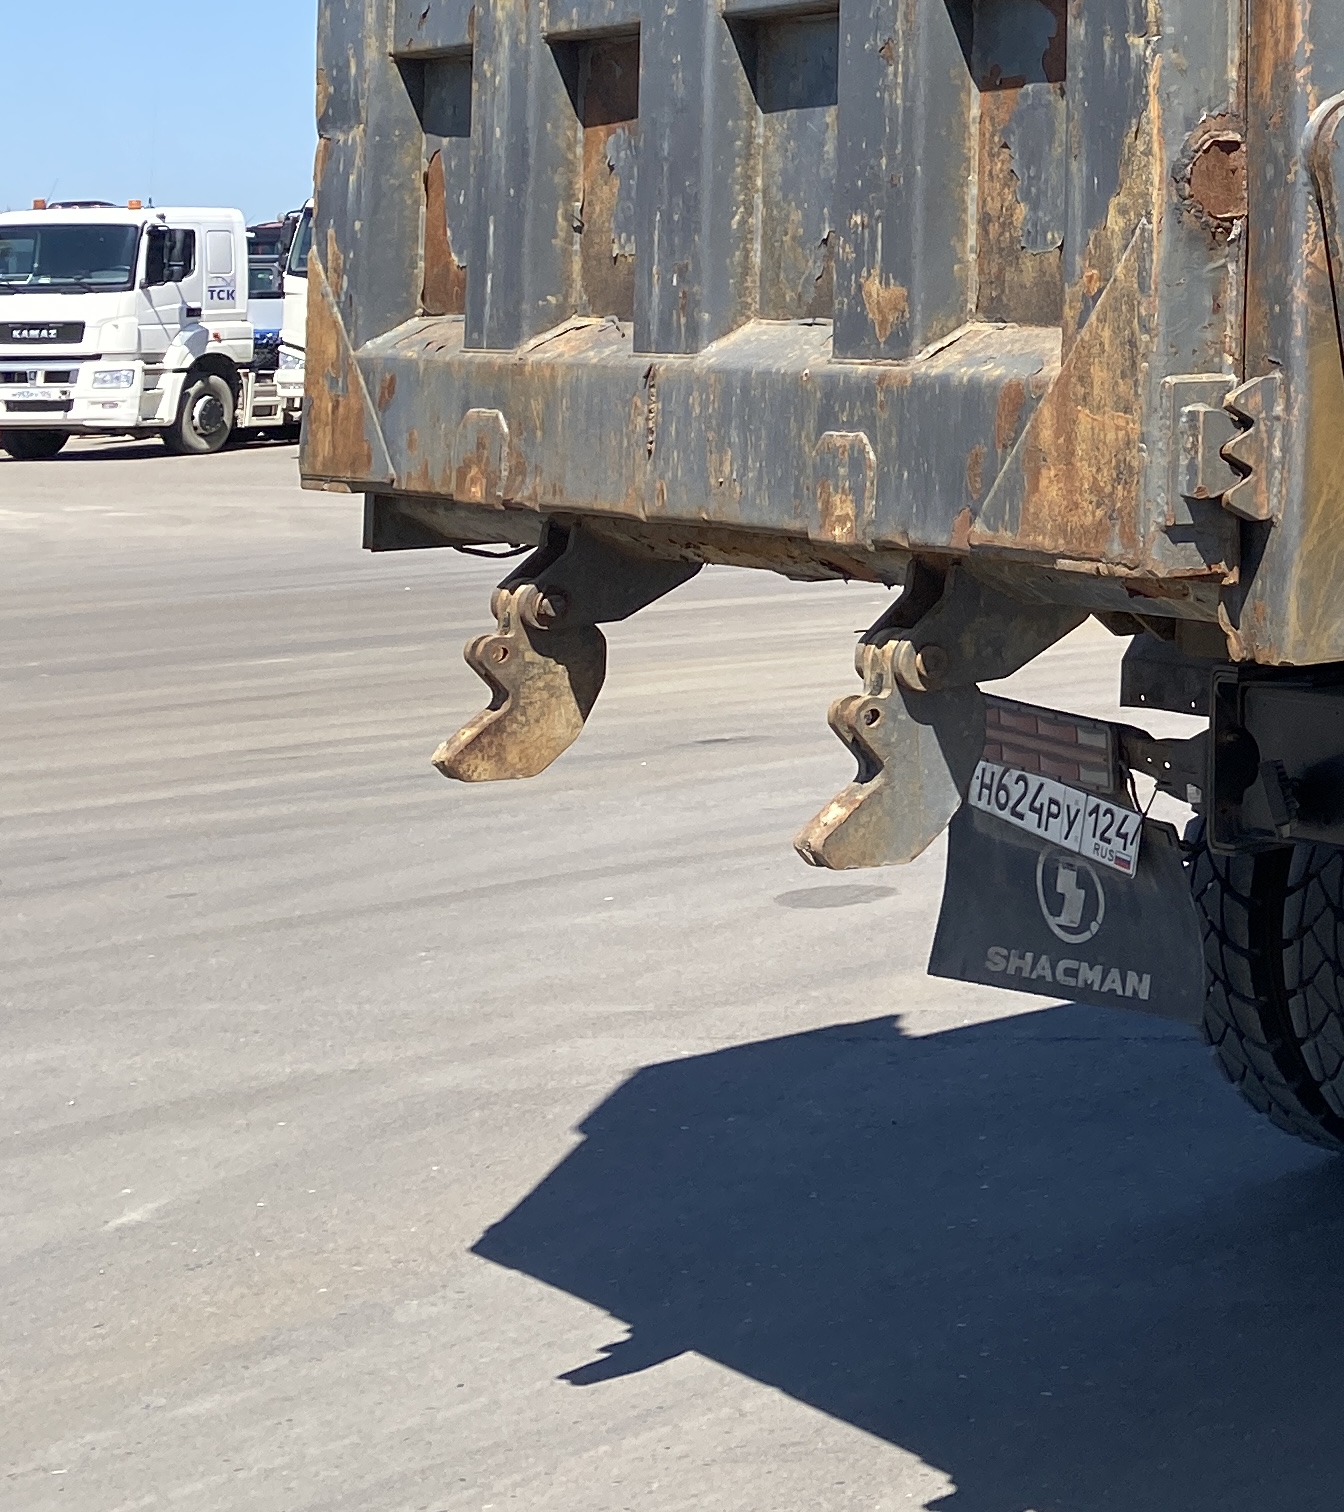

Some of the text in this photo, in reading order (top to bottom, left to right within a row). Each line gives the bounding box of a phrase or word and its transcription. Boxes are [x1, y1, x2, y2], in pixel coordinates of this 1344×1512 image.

[12, 329, 57, 339] KAMAZ
[1087, 802, 1131, 852] 124
[1092, 842, 1115, 863] RUS
[985, 945, 1152, 1002] SHACMAN
